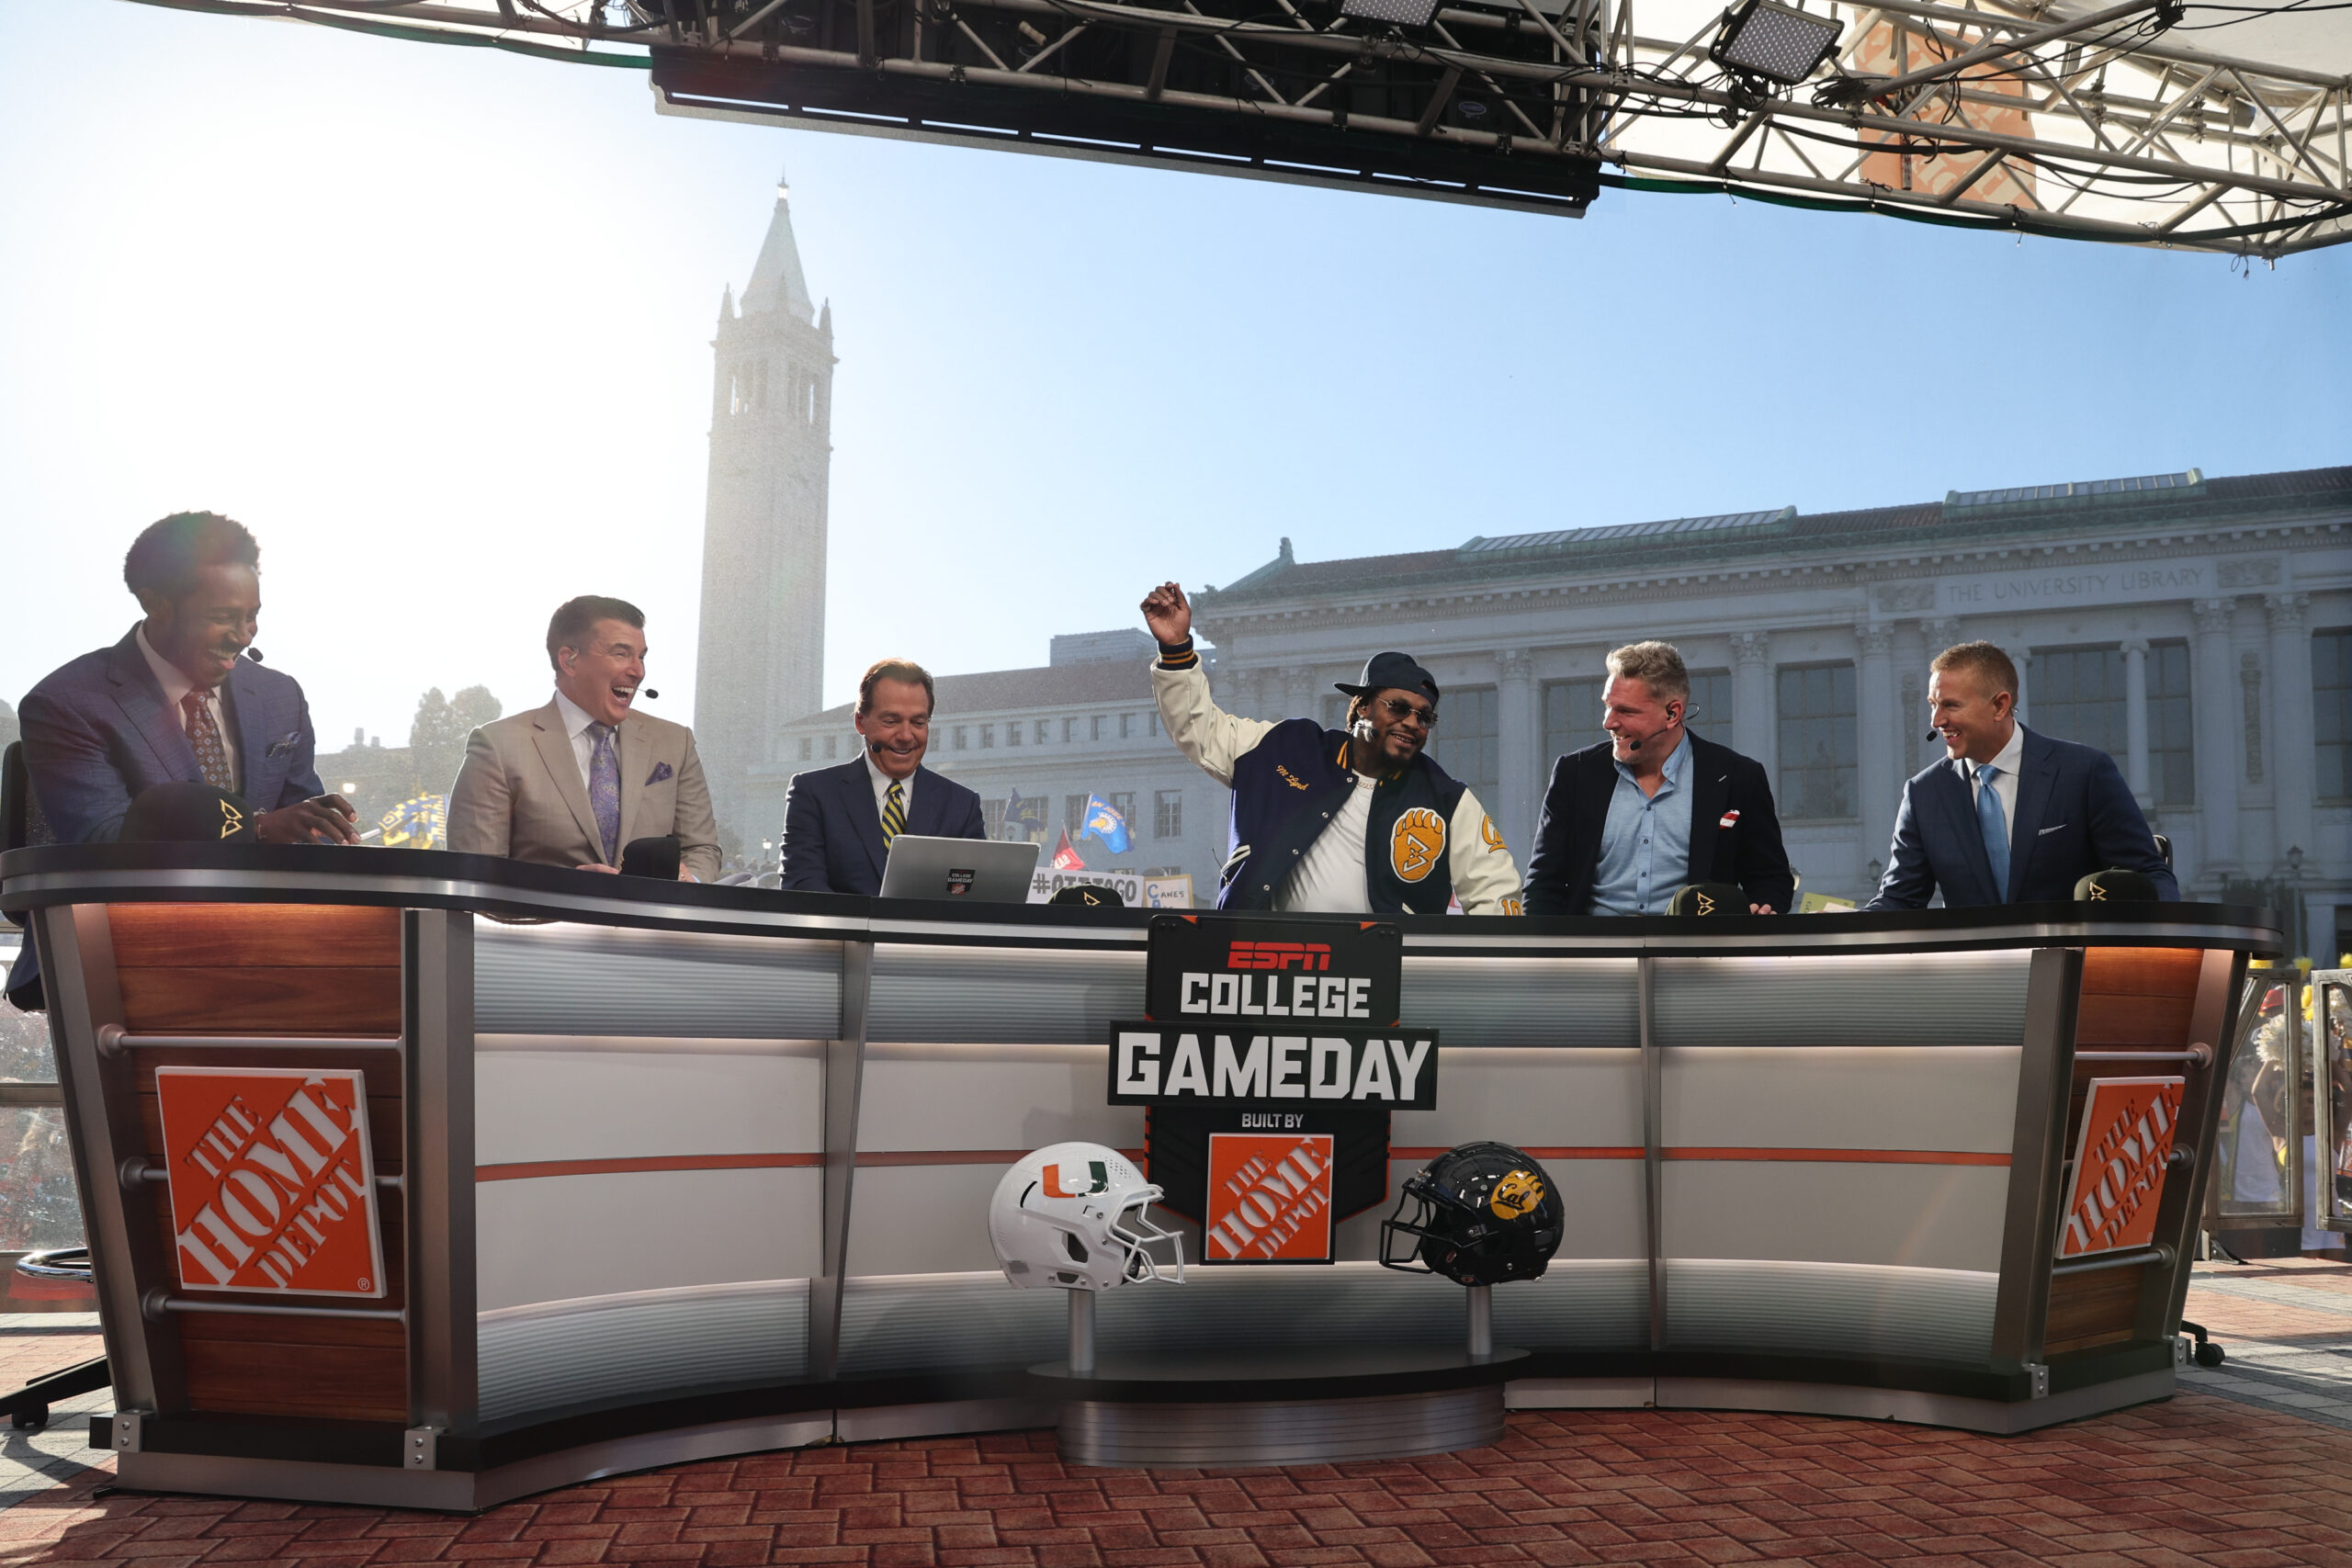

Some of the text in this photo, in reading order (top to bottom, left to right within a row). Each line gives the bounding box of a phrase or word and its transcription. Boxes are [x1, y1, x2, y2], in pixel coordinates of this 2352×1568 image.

[1948, 568, 2204, 603] THE UNIVERSITY LIBRARY
[1482, 814, 1508, 854] Ca
[1227, 941, 1331, 970] ESPN
[1181, 972, 1372, 1019] COLLEGE
[1117, 1032, 1431, 1100] GAMEDAY
[183, 1094, 263, 1179] THE
[1241, 1112, 1305, 1129] BUILT BY
[2094, 1099, 2138, 1164] THE
[176, 1077, 359, 1286] HOME
[1043, 1161, 1109, 1198] U
[1208, 1137, 1331, 1259] HOME
[1222, 1149, 1273, 1198] THE
[1497, 1182, 1530, 1211] Cal
[2069, 1083, 2180, 1250] HOME
[2103, 1143, 2168, 1247] DEPOT
[254, 1156, 366, 1289] DEPOT
[1257, 1182, 1330, 1259] DEPOT
